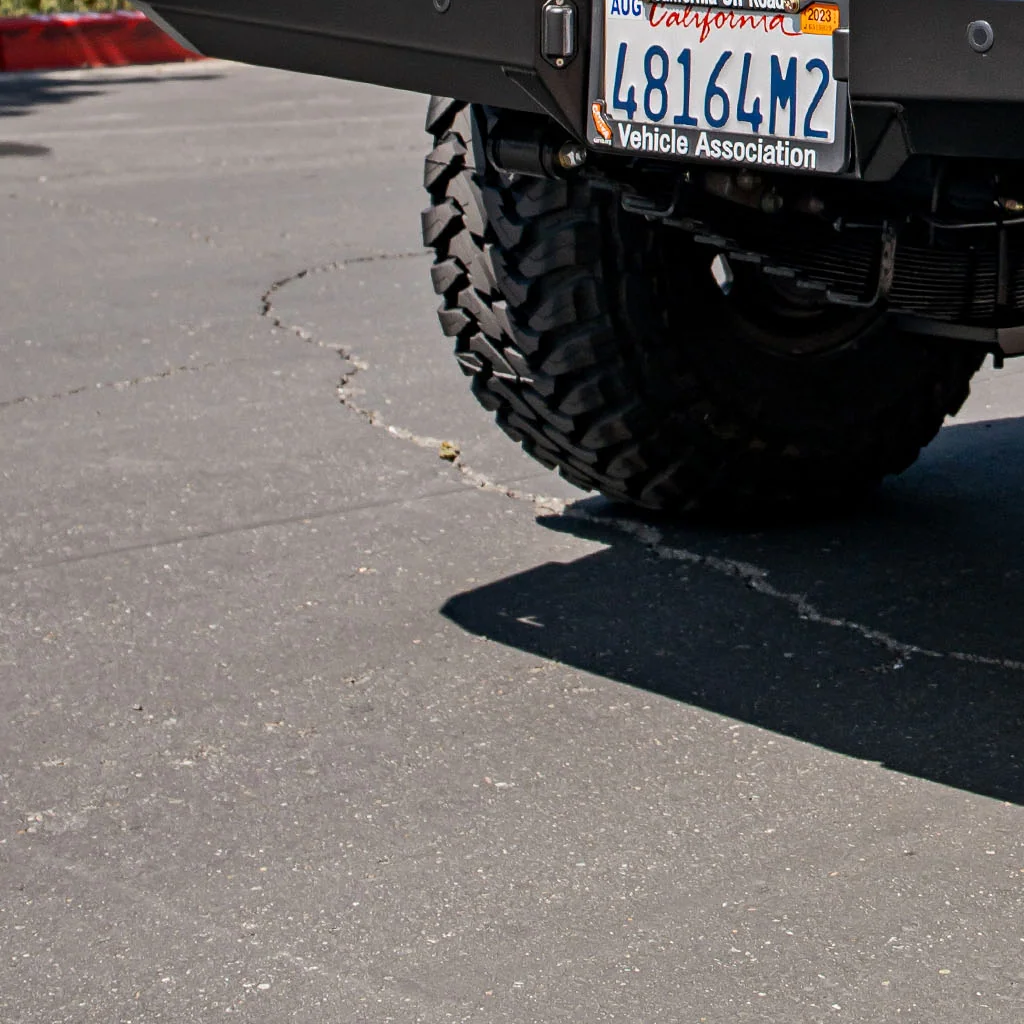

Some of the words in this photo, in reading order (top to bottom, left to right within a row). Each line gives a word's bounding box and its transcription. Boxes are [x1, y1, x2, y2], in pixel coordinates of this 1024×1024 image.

[650, 2, 802, 43] California
[808, 8, 831, 22] 2023
[613, 42, 830, 138] 48164M2
[618, 123, 688, 154] Vehicle
[695, 132, 817, 169] Association
